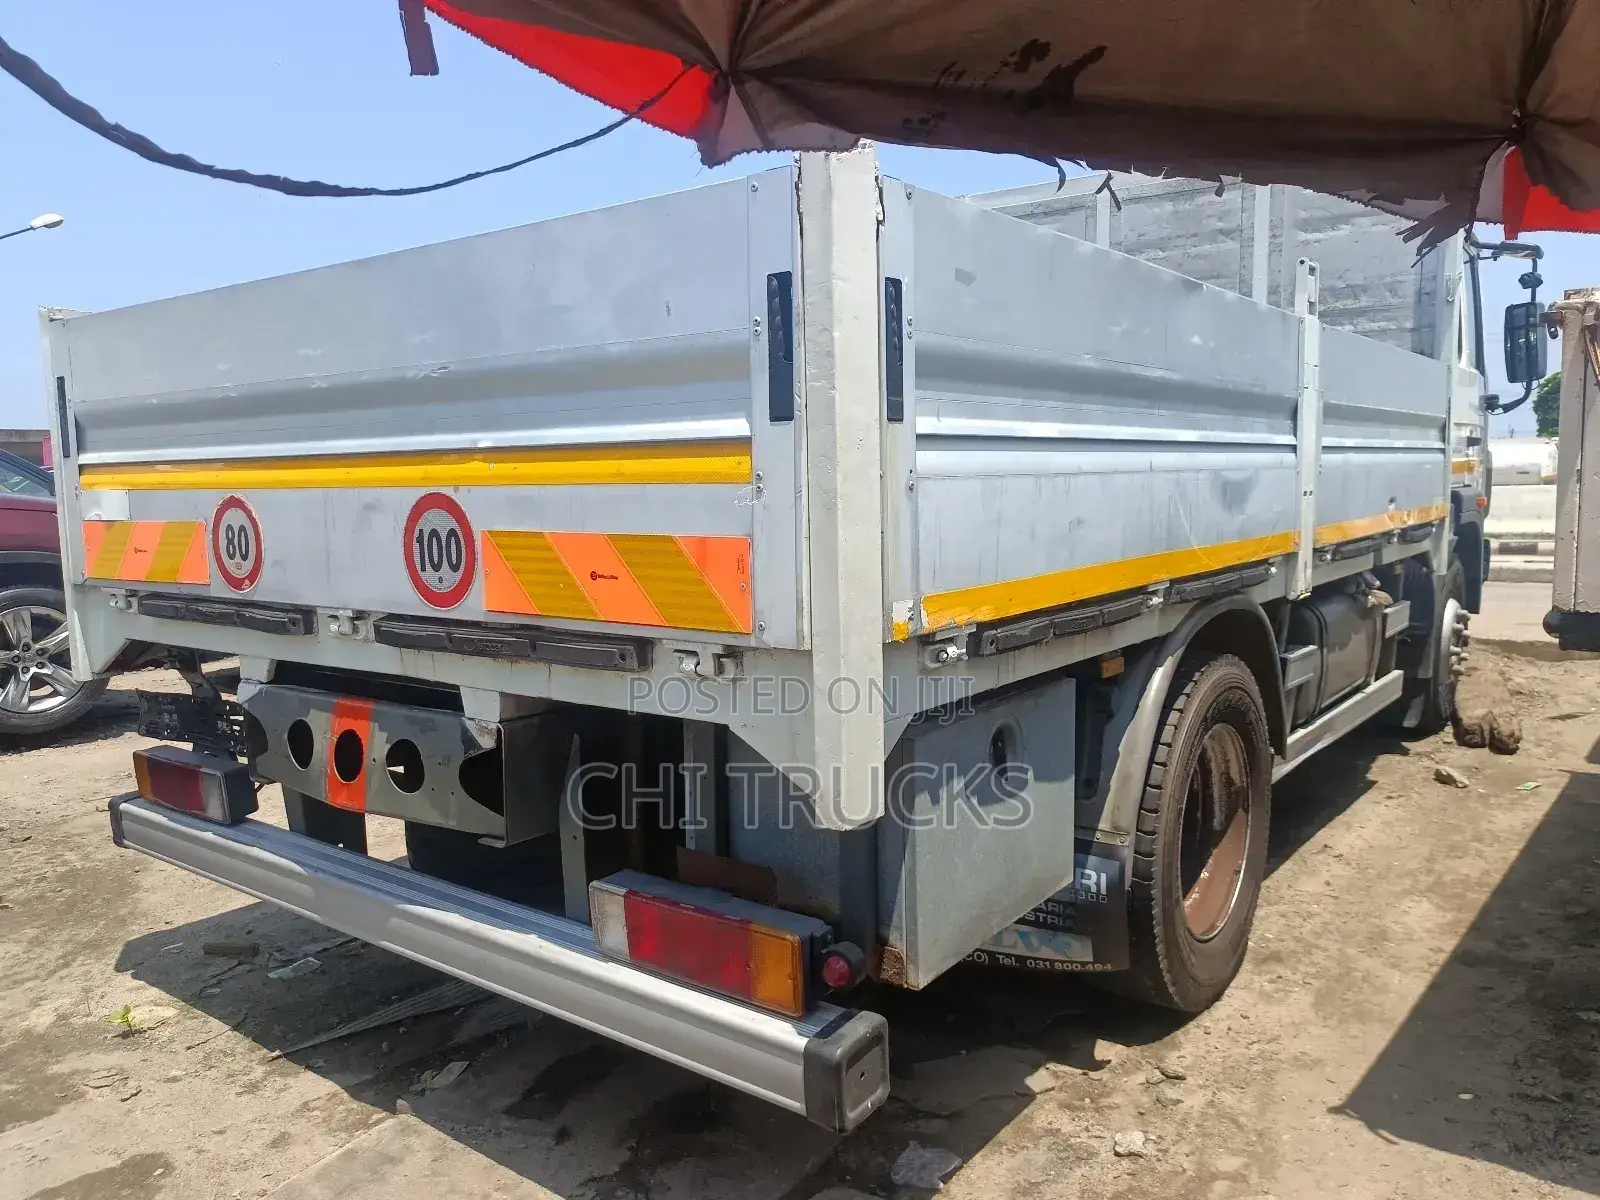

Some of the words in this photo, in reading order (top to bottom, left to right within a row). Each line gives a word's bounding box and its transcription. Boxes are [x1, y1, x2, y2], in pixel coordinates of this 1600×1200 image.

[225, 523, 250, 562] 80
[415, 527, 463, 574] 100
[996, 954, 1020, 969] Tel.
